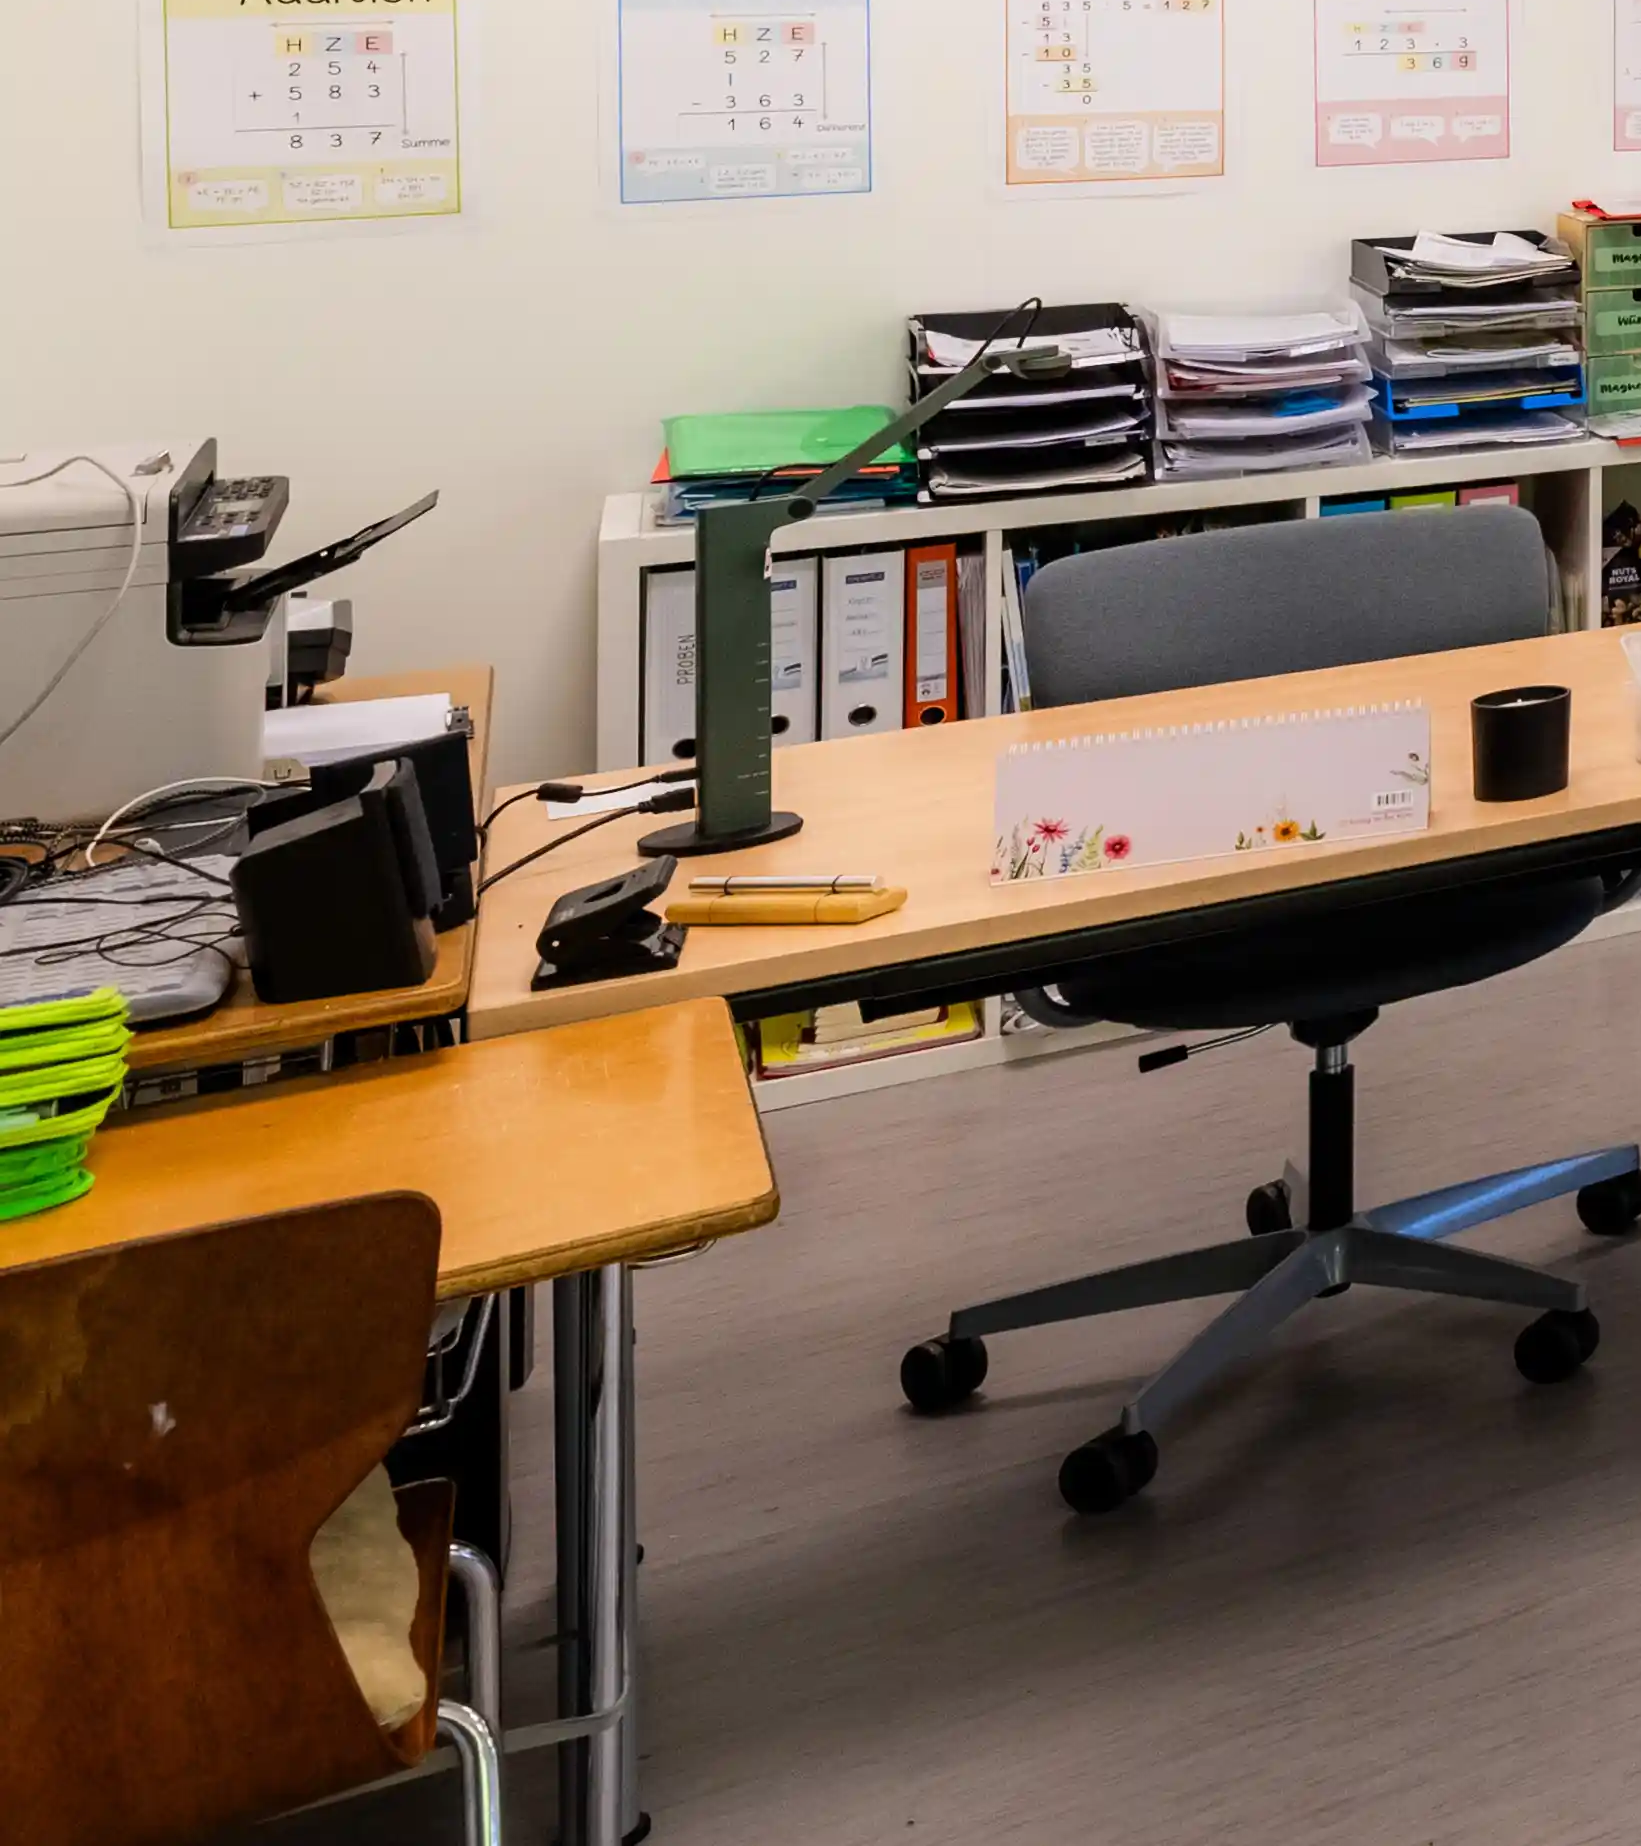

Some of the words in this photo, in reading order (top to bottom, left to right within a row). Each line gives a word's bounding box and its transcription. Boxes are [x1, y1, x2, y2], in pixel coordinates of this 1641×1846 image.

[286, 38, 301, 52] H
[326, 37, 342, 51] Z
[366, 36, 380, 50] E
[288, 63, 300, 76] 2
[328, 61, 341, 75] 5
[366, 60, 381, 73] 4
[402, 138, 450, 148] Summe
[1612, 567, 1637, 576] NUTS
[1609, 574, 1640, 584] ROYAL
[676, 634, 696, 685] PROBEN
